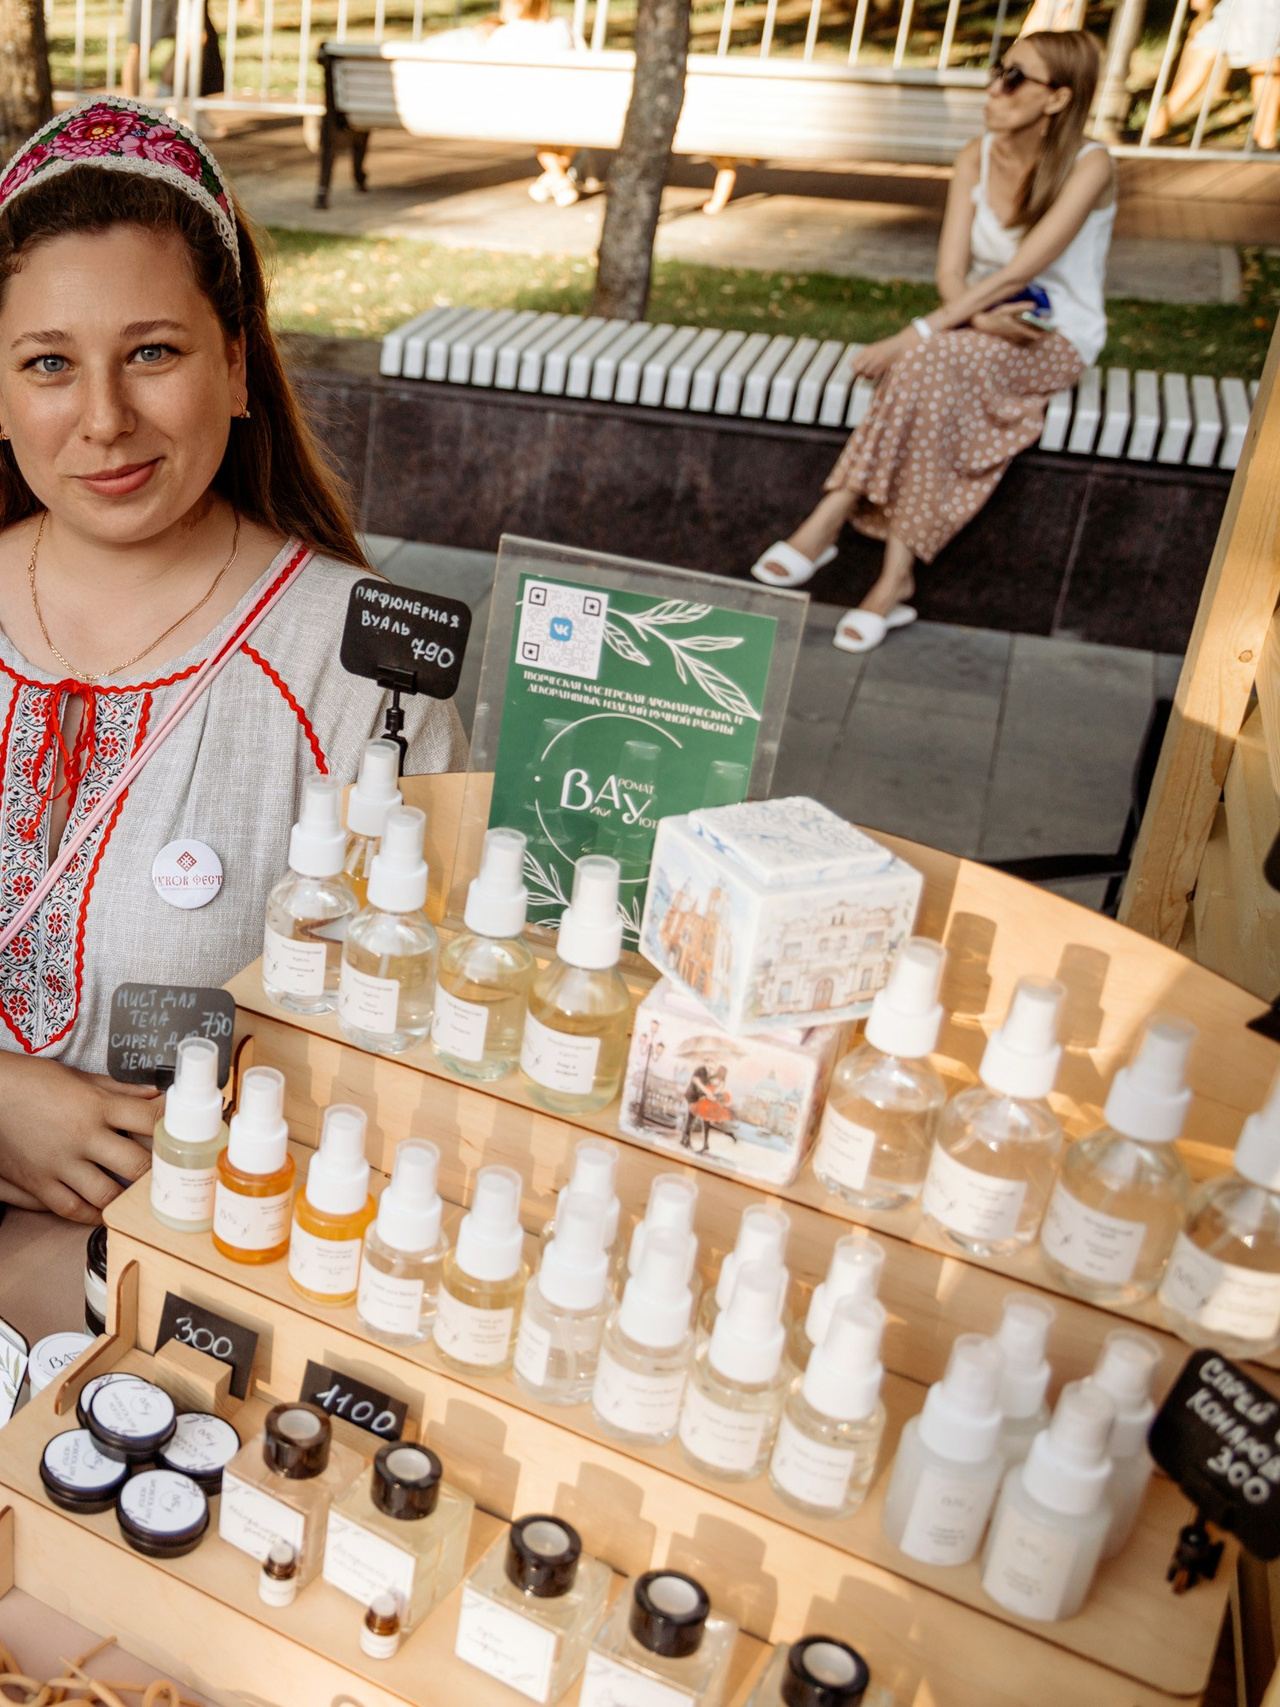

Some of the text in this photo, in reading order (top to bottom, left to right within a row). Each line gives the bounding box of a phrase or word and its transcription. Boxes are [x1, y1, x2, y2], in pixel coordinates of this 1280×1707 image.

[355, 585, 461, 629] ПАРФЮМЕРНАЯ
[361, 609, 411, 637] ВУАЛЬ
[522, 669, 744, 726] ТВОРЧЕСКАЯ МАСТЕРСКАЯ АРОМАТИЧЕСКИХ И
[526, 682, 735, 736] ДЕКОРАТИВНЫХ ИЗДЕЛИЙ РУЧНОЙ РАБОТЫ
[560, 767, 652, 825] ВАУ
[117, 988, 198, 1009] МИСТ ДЛЯ
[129, 1009, 170, 1029] ТЕЛА
[111, 1028, 159, 1049] СПРЕЙ
[200, 1011, 233, 1039] 750
[174, 1316, 234, 1358] 300
[316, 1384, 397, 1432] 1100
[1206, 1445, 1271, 1504] 300
